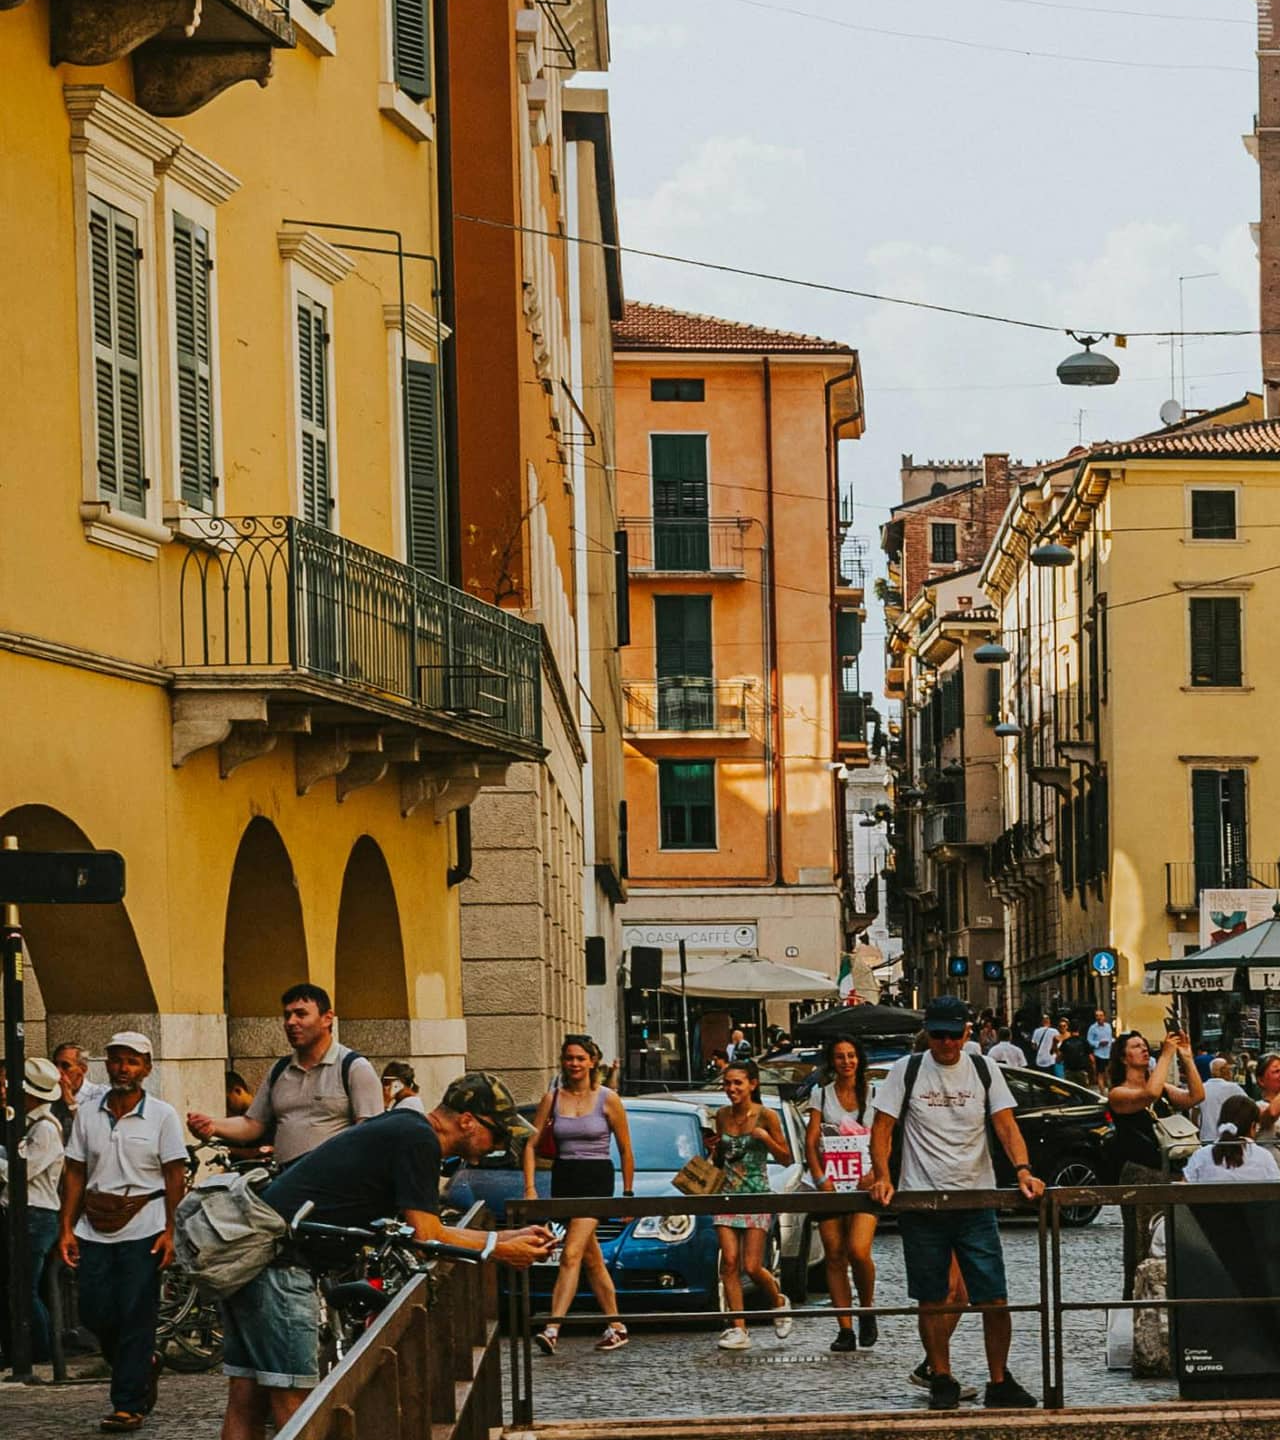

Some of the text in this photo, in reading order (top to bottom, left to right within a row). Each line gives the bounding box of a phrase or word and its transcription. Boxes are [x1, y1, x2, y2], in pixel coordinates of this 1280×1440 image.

[646, 932, 681, 944] CASA
[1171, 975, 1224, 989] L'Arena
[825, 1159, 861, 1180] ALE
